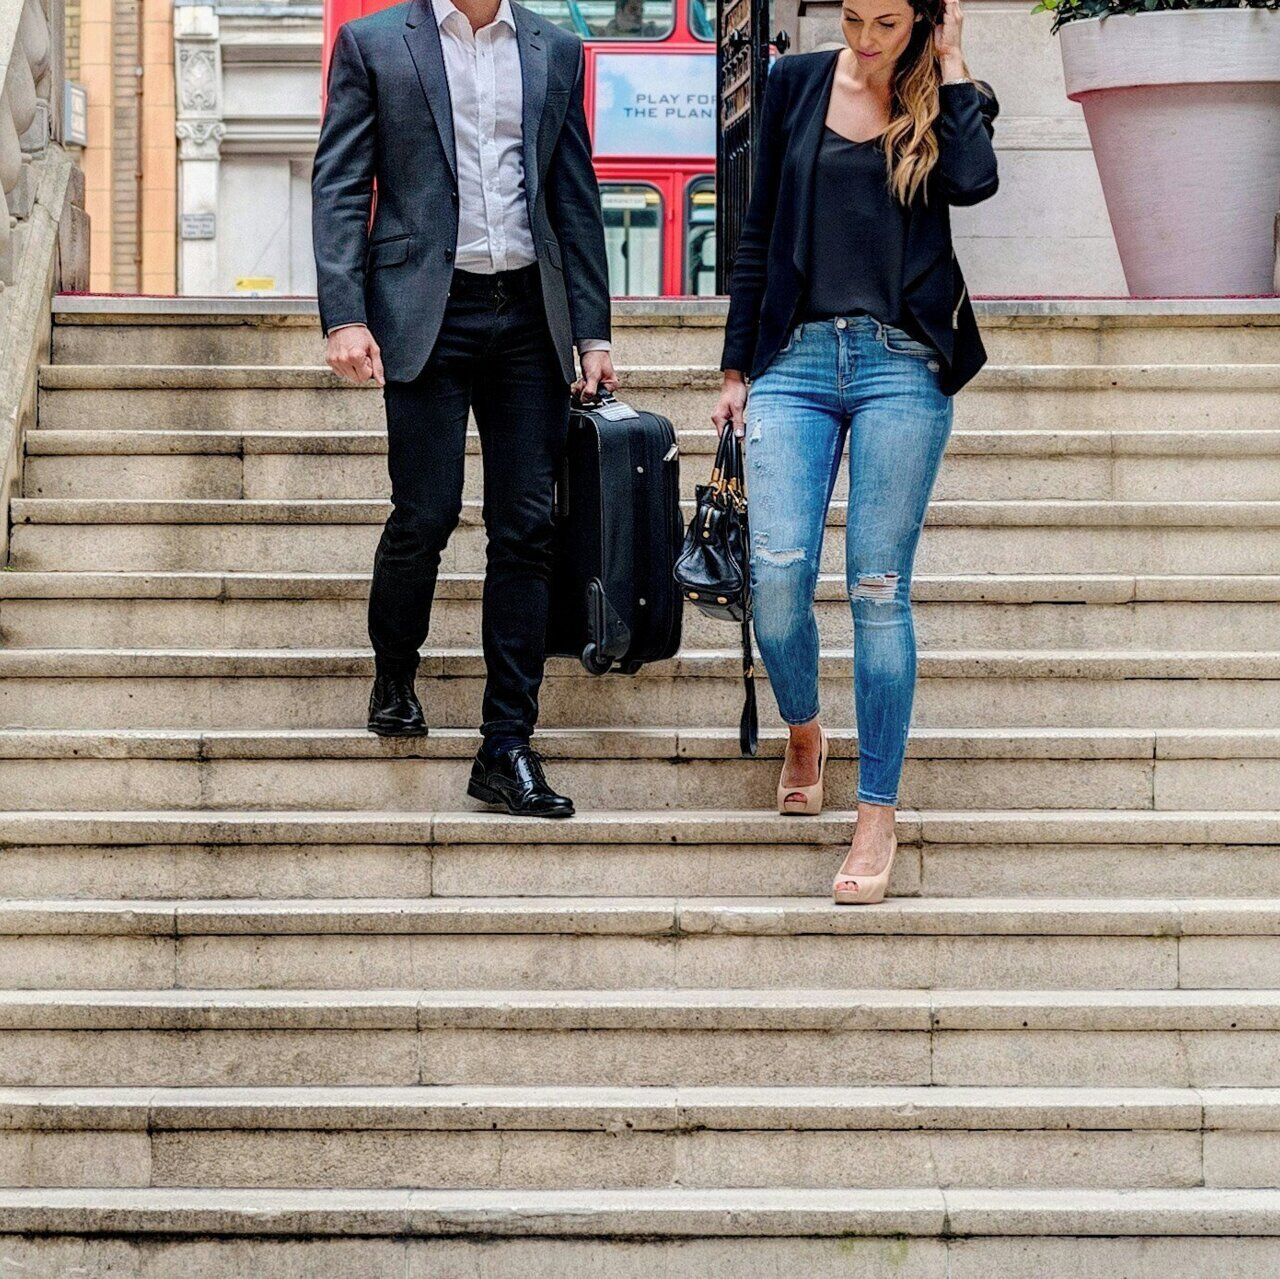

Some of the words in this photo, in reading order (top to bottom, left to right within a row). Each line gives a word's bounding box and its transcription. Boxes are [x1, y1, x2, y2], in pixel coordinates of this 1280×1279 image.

[636, 94, 679, 104] PLAY
[623, 107, 657, 118] THE
[665, 107, 716, 118] PLAN
